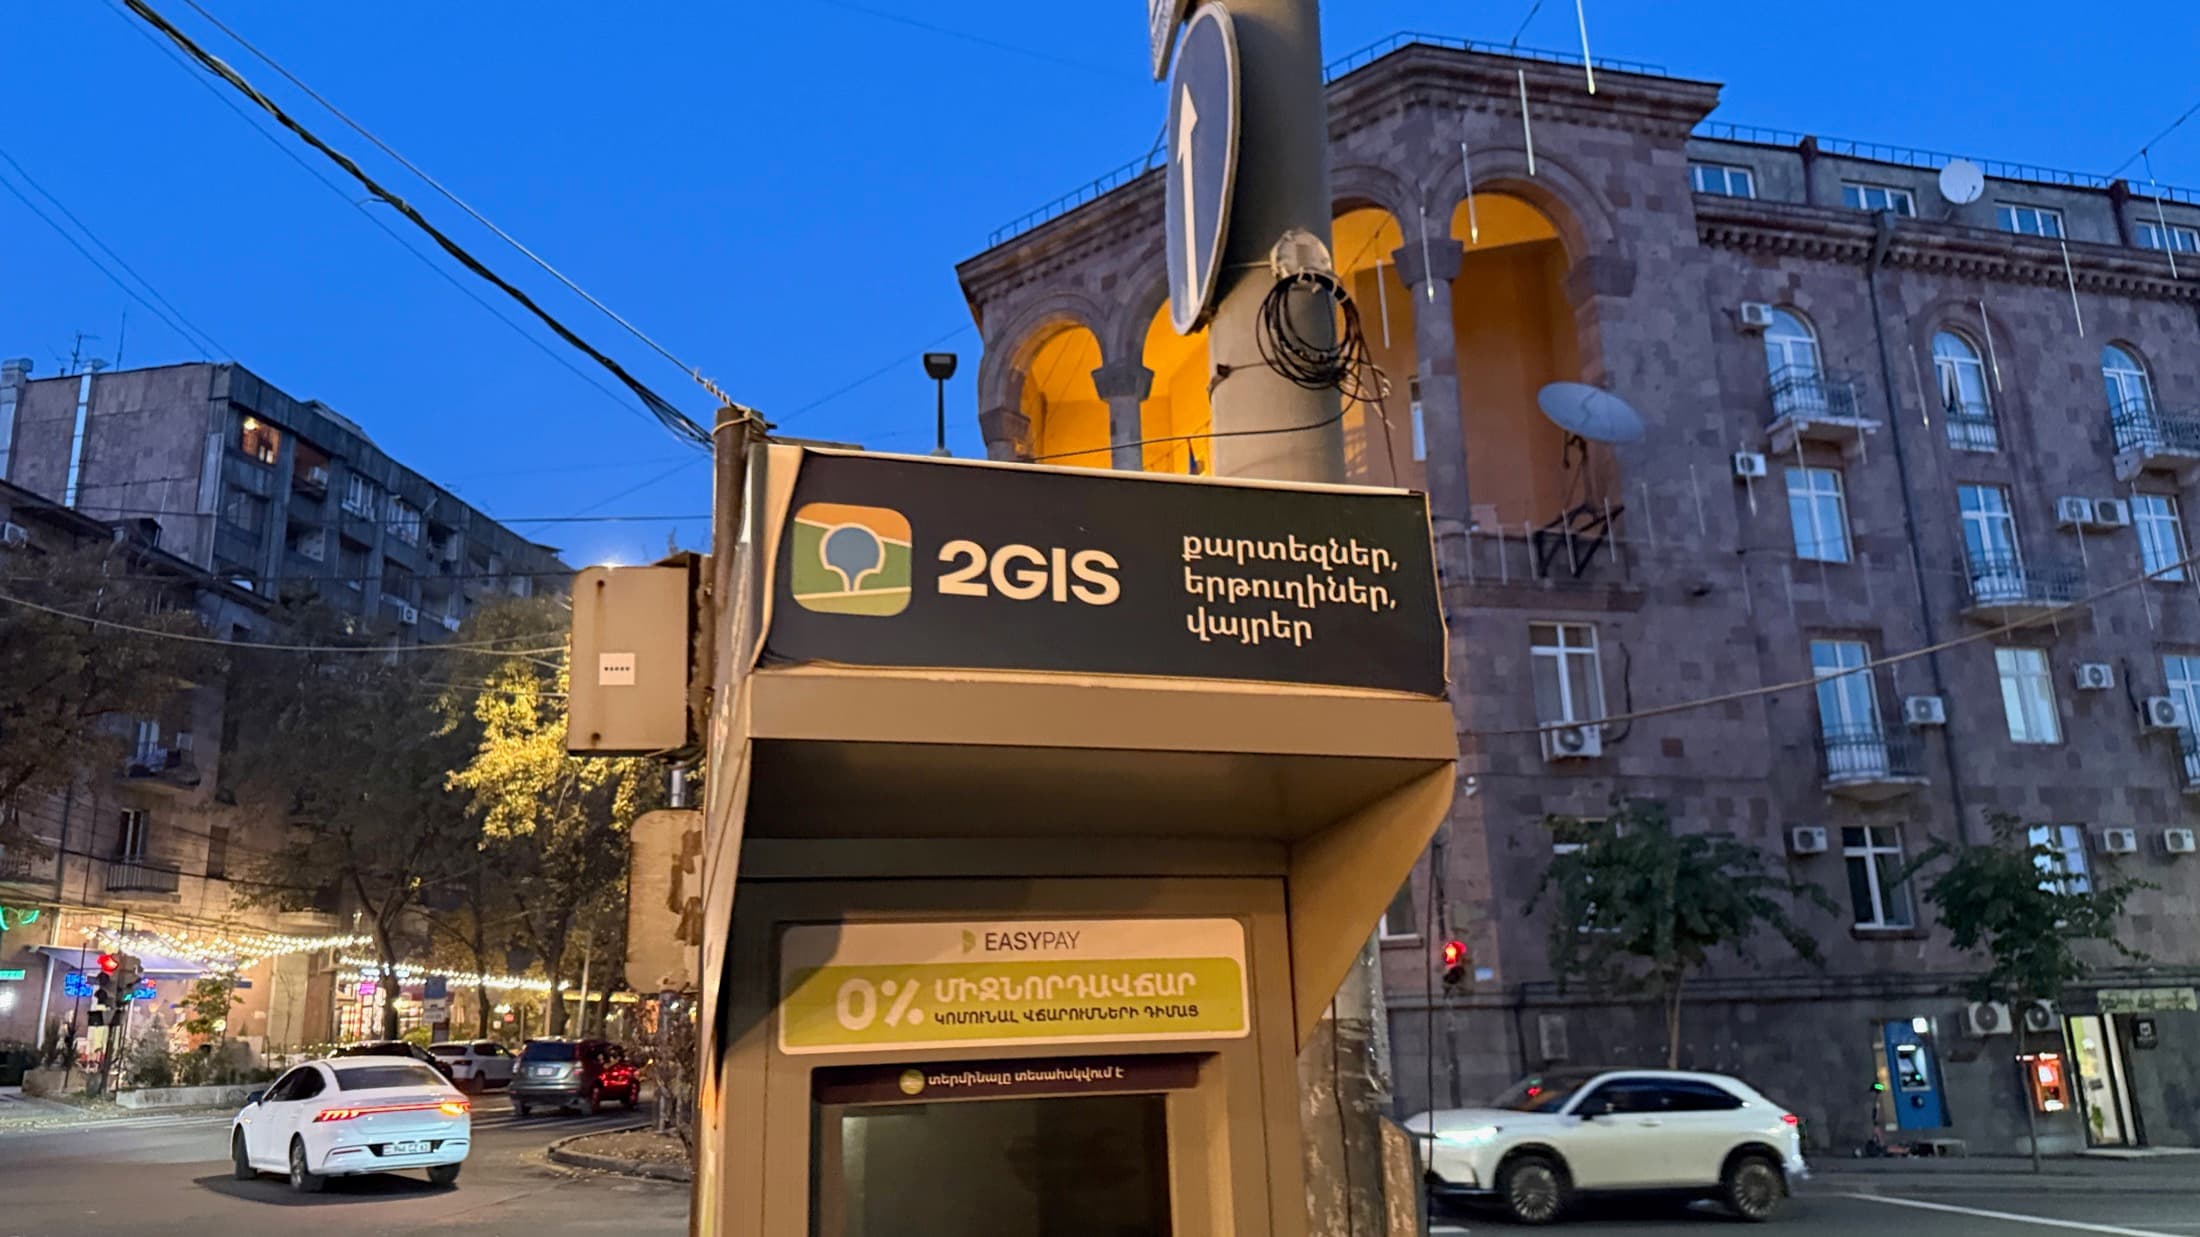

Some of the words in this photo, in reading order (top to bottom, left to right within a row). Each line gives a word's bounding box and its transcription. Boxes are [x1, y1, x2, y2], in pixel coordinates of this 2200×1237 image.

[937, 539, 1121, 605] 2GIS
[1182, 534, 1398, 574] քարտեզներ,
[1184, 566, 1397, 612] երթուղիներ,
[1186, 606, 1312, 647] վայրեր
[984, 930, 1080, 951] EASYPAY
[837, 979, 923, 1031] 0%
[934, 973, 1196, 1002] ՄԻՋՆՈՐԴԱՎՃԱՐ
[934, 1009, 1018, 1024] ԿՈՄՈՒՆԱԼ
[1023, 1006, 1139, 1020] ՎՃԱՐՈՒՄՆԵՐԻ
[1144, 1004, 1200, 1018] ԴԻՄԱՑ
[928, 1072, 1012, 1087] տերմինալը
[1014, 1067, 1113, 1082] տեսահսկվում
[1115, 1066, 1125, 1078] է
